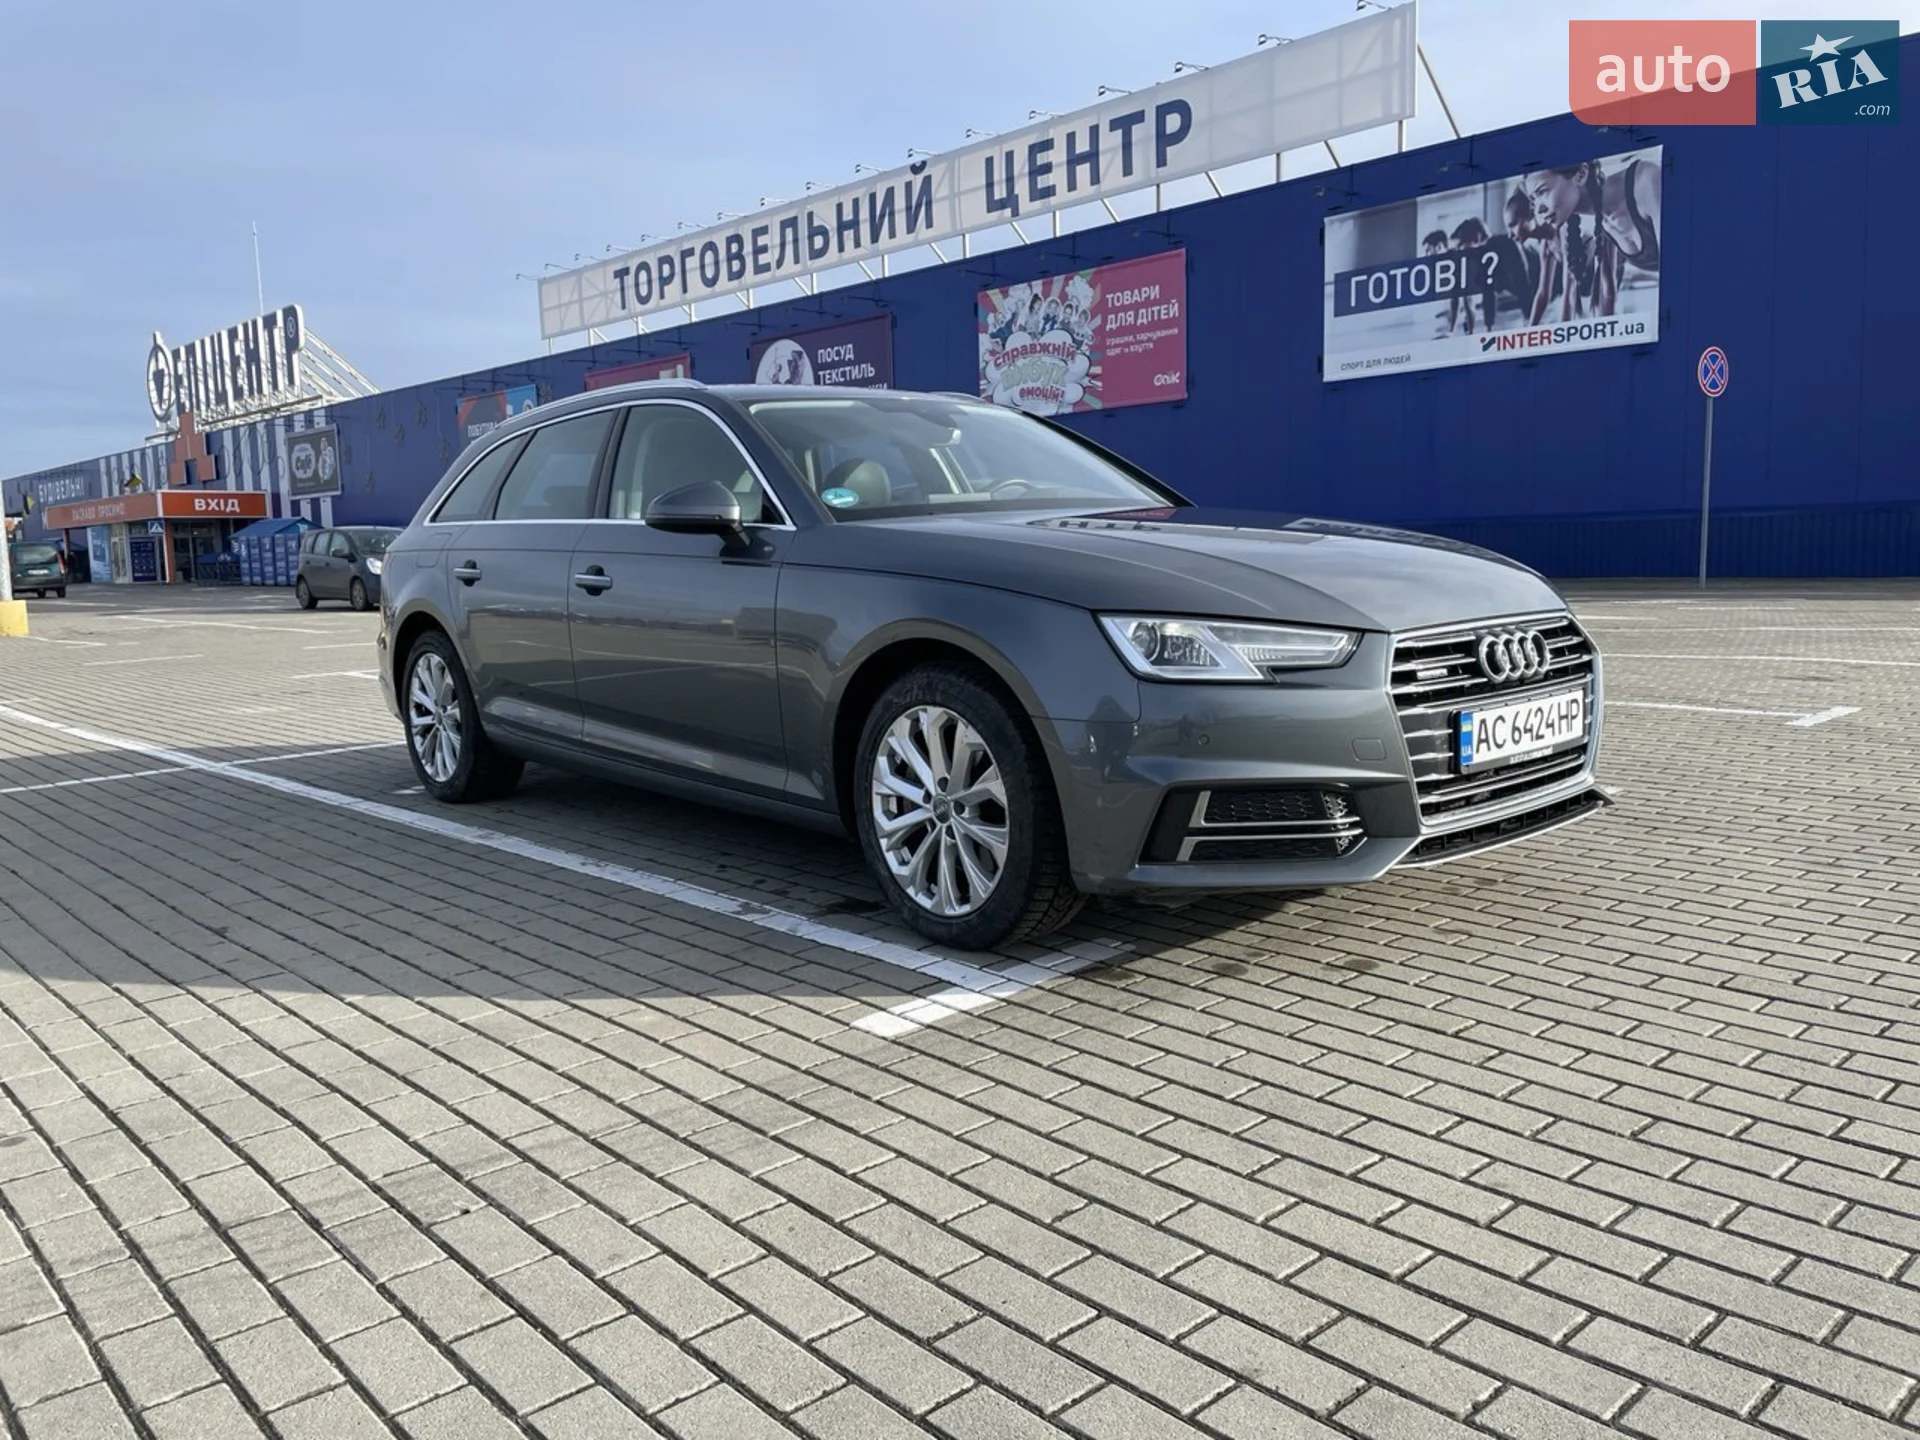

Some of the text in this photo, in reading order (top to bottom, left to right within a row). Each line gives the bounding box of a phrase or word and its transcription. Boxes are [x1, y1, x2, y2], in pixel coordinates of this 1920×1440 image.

[613, 98, 1193, 311] ТОРГОВЕЛЬНИЙ ЦЕНТР
[1351, 251, 1499, 307] ГОТОВІ ?
[1105, 284, 1160, 308] ТОВАРИ
[1105, 298, 1180, 332] ДЛЯ ДІТЕЙ
[1497, 320, 1645, 351] INTERSPORT.ua
[171, 304, 305, 417] ЕПІЦЕНТР
[817, 343, 855, 364] ПОСУД
[993, 341, 1077, 368] справжній
[1341, 354, 1411, 371] СПОРТ ДЛЯ ЛЮДЕЙ
[817, 362, 876, 385] ТЕКСТИЛЬ
[1018, 385, 1065, 403] емоцій!
[194, 498, 240, 513] ВХІД
[1476, 698, 1580, 754] AC 6424 HP
[1461, 745, 1472, 757] UA
